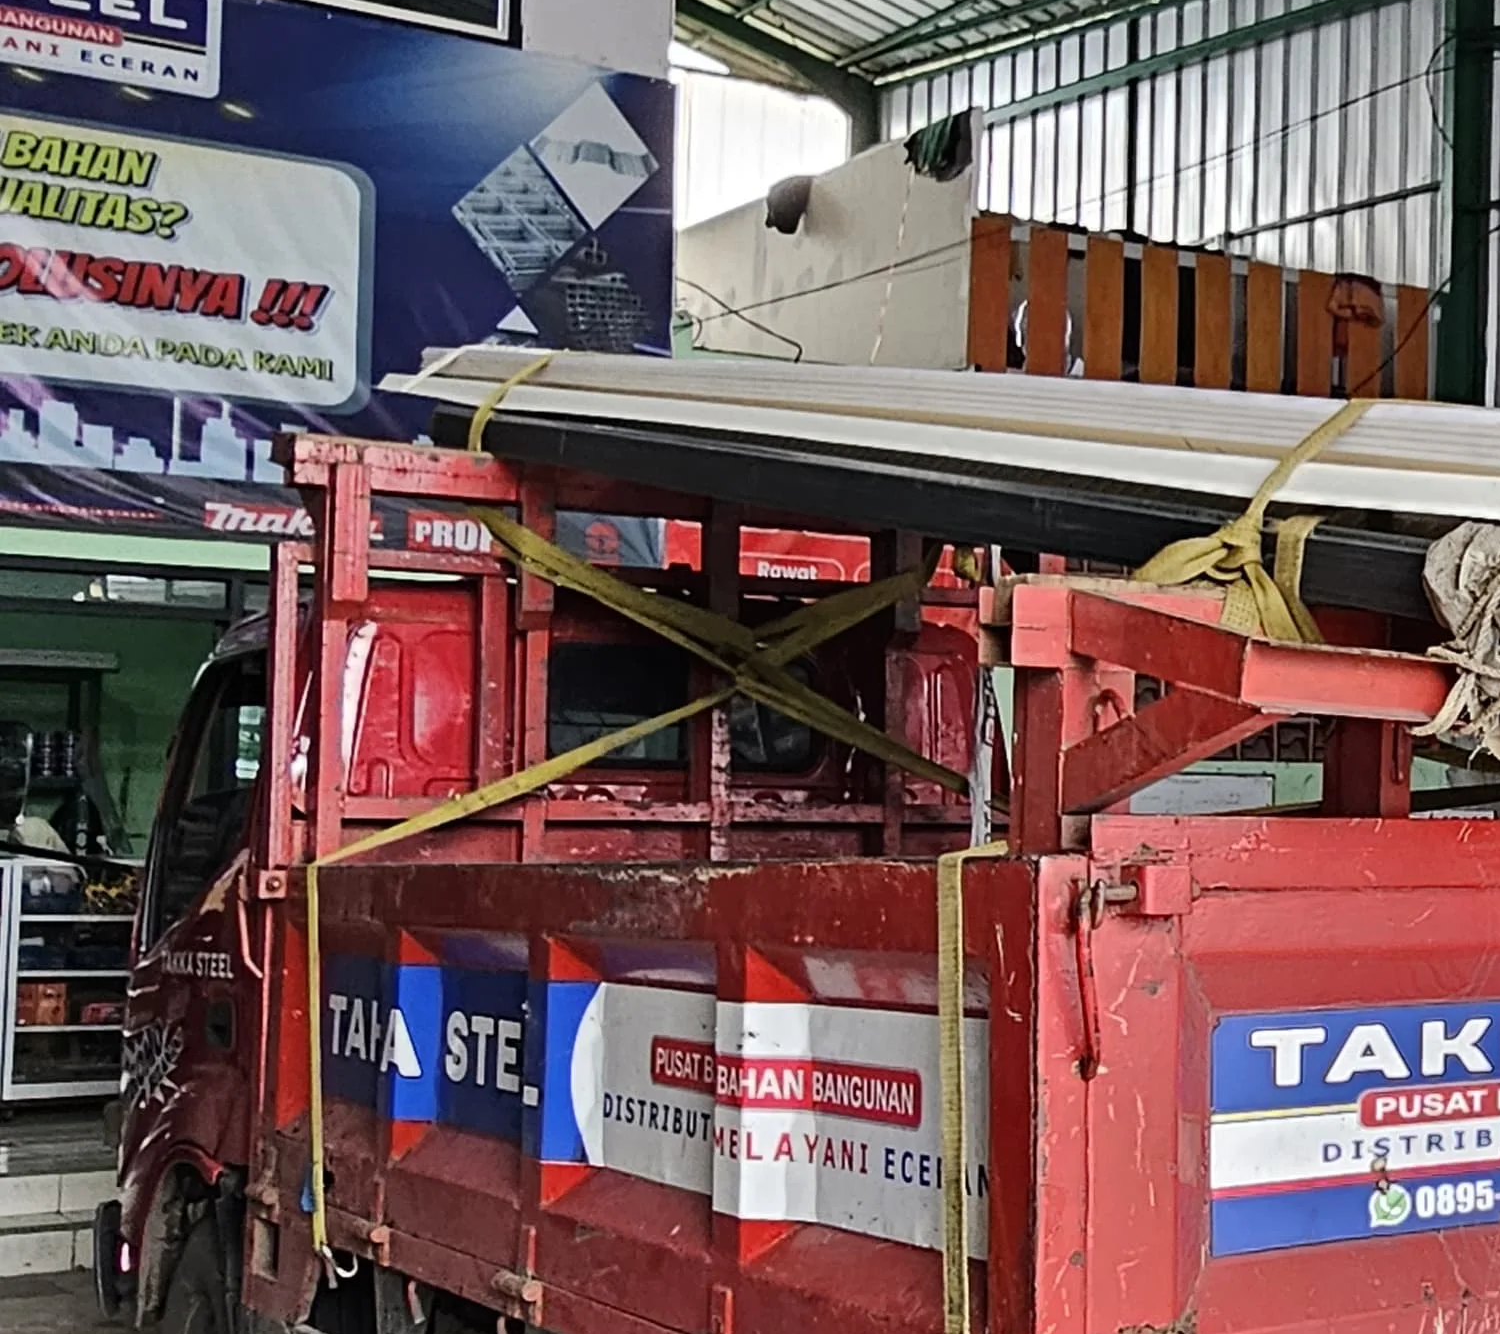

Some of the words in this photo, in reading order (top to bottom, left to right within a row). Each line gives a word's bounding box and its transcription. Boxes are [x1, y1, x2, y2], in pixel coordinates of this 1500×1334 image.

[0, 9, 115, 44] ANGUNAN
[80, 49, 199, 82] ECERAN
[2, 131, 157, 187] BAHAN
[44, 328, 149, 360] ANDA
[155, 339, 247, 371] PADA
[253, 350, 336, 382] KAMI
[756, 560, 819, 581] Rawat
[196, 952, 235, 979] STEEL
[655, 1046, 701, 1082] PUSAT
[716, 1064, 805, 1101] BAHAN
[811, 1071, 916, 1117] BANGUNAN
[602, 1091, 712, 1142] DISTRIBUT
[1374, 1089, 1488, 1121] PUSAT
